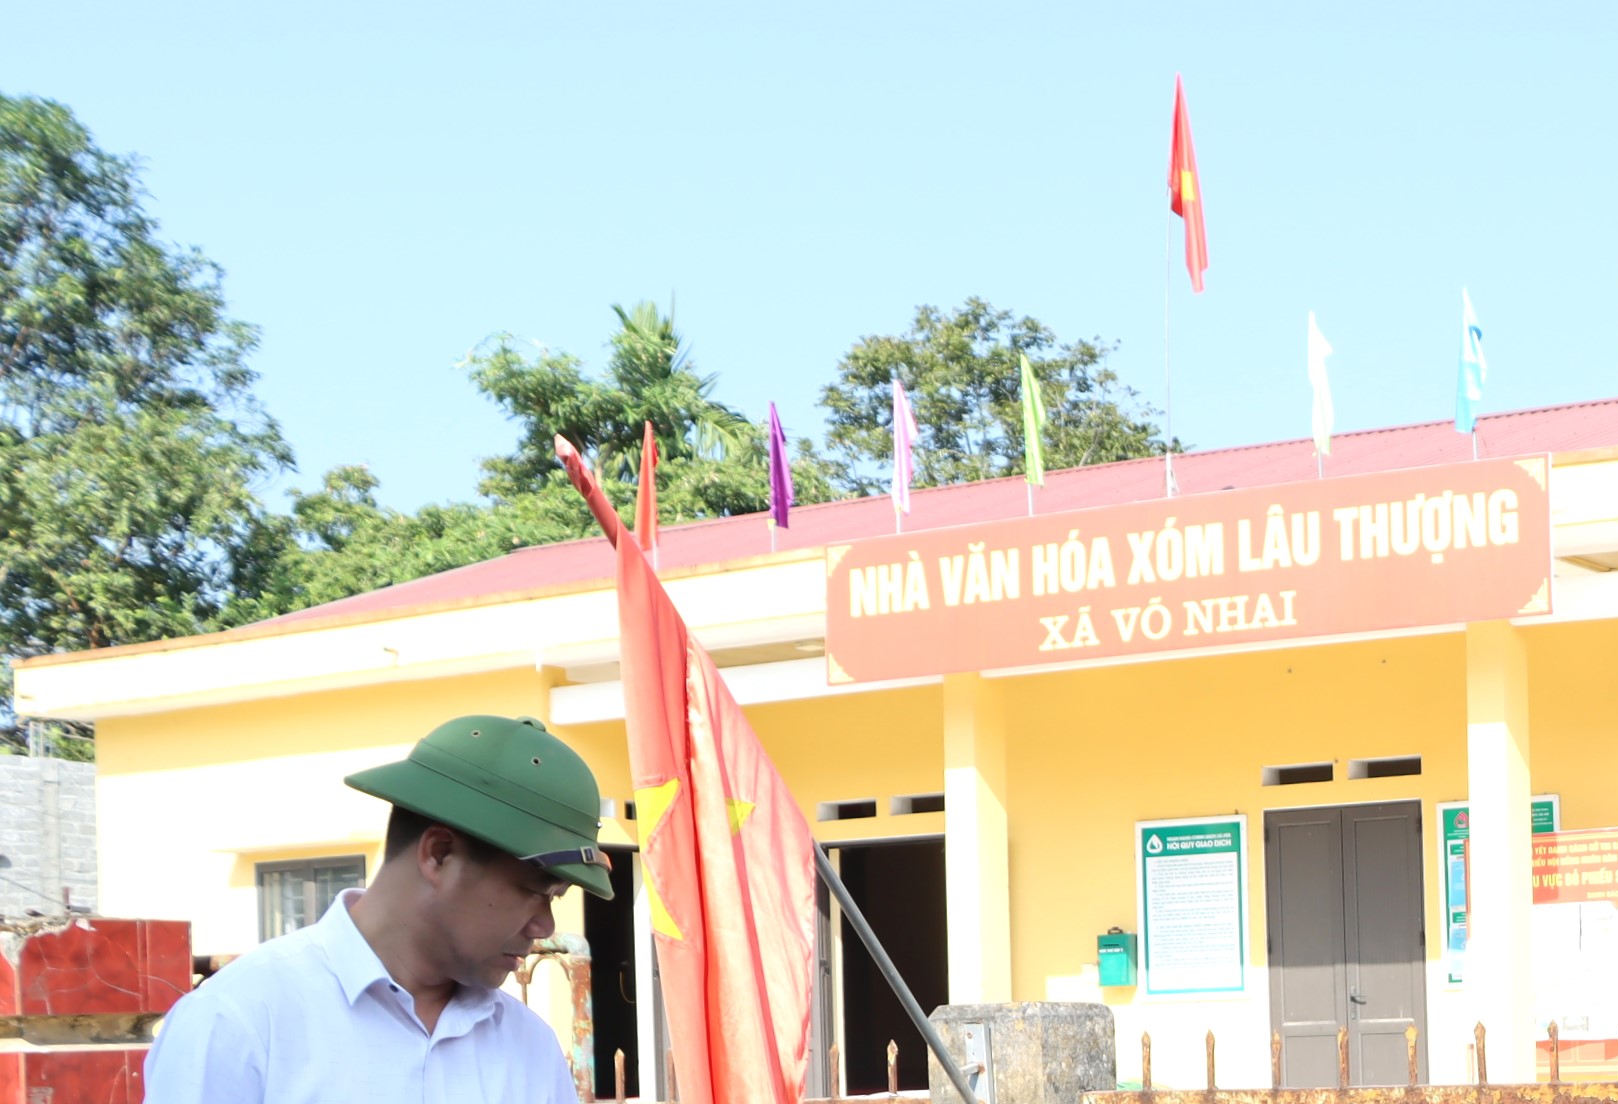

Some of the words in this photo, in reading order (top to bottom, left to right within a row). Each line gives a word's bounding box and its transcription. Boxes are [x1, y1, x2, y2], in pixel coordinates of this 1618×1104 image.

[849, 555, 930, 618] NHÀ
[939, 543, 1021, 606] VĂN
[1033, 529, 1113, 596] HÓA
[1127, 516, 1224, 583] XÓM
[1237, 502, 1320, 571] LÂU
[1334, 489, 1520, 566] THƯỢNG
[1038, 604, 1101, 651] XÃ
[1111, 596, 1174, 643] VÕ
[1182, 590, 1297, 636] NHAI
[1542, 873, 1563, 890] VỰC
